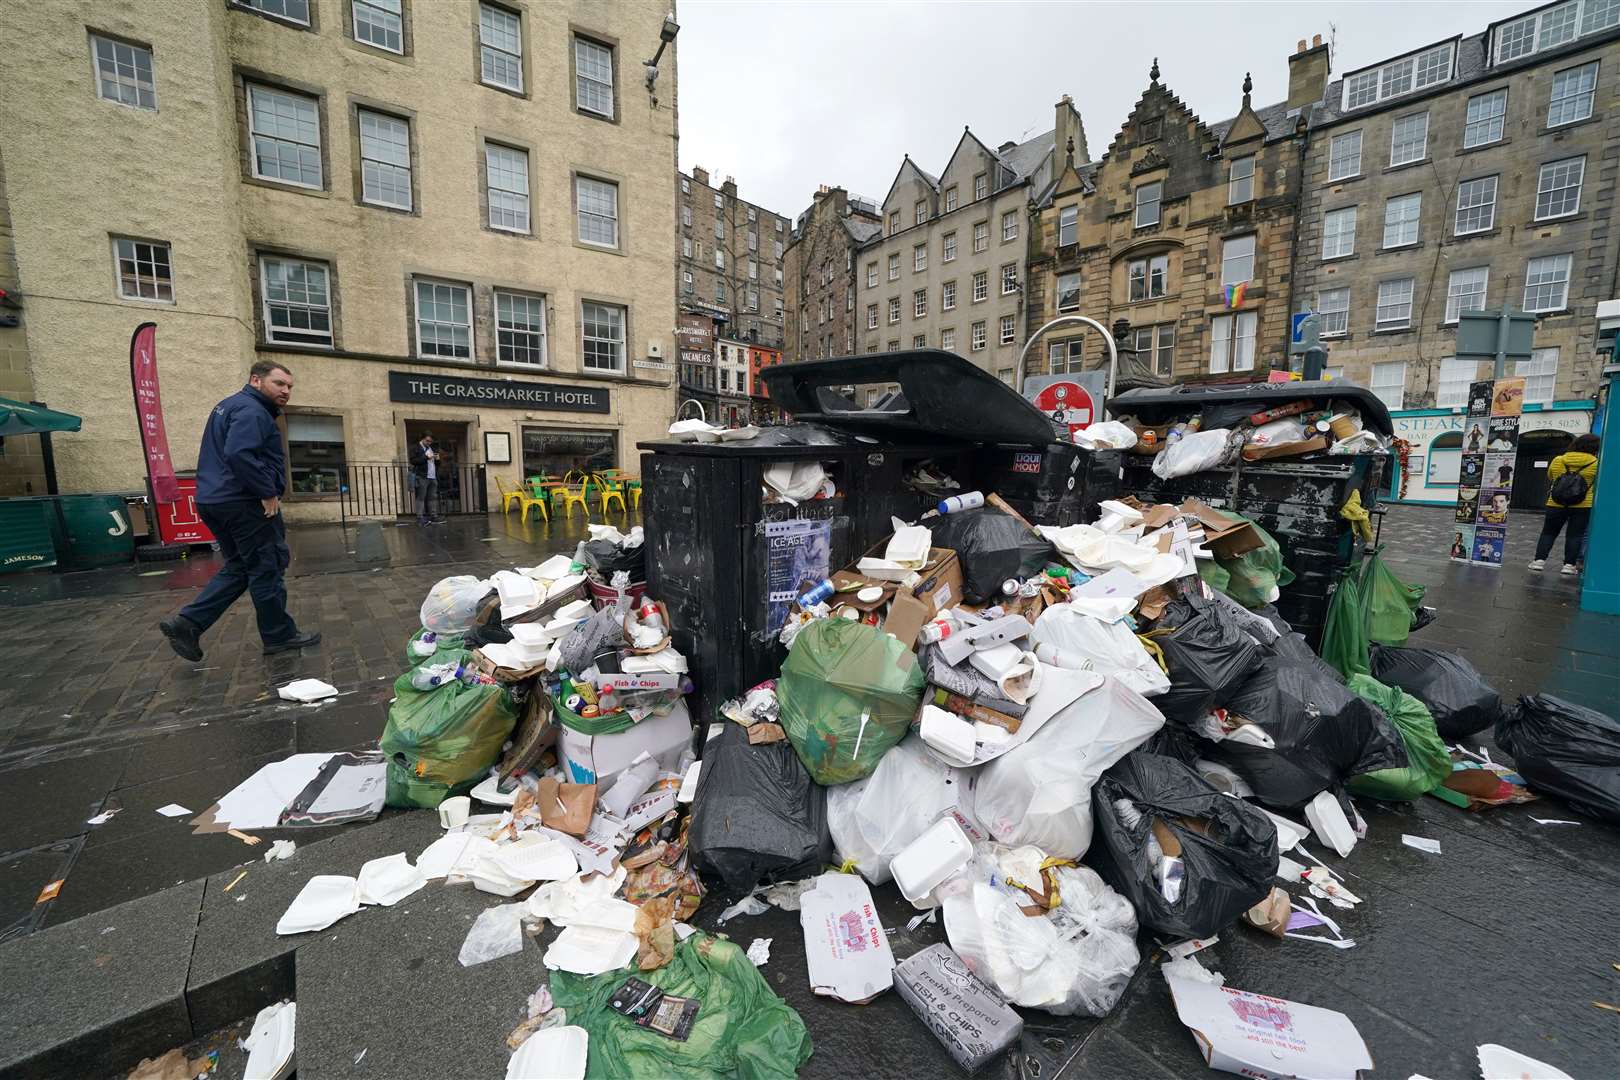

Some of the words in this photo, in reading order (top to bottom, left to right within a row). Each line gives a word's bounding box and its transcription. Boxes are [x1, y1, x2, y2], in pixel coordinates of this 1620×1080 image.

[681, 351, 712, 363] VACANCIES
[408, 380, 441, 396] THE
[444, 383, 551, 403] GRASSMARKET
[554, 391, 597, 406] HOTEL
[1399, 416, 1464, 432] STEAK
[1016, 454, 1040, 463] LIQUI
[1014, 463, 1039, 472] MOLY
[770, 537, 786, 548] ICE
[788, 535, 806, 546] AGE
[3, 554, 45, 565] JAMESON
[614, 679, 629, 687] Fish
[630, 679, 638, 687] &
[639, 680, 660, 688] Chips
[863, 904, 873, 918] Fish
[870, 927, 880, 949] Chips
[919, 970, 952, 997] Freshly
[952, 994, 1000, 1026] Prepared
[912, 982, 937, 1003] FISH
[937, 1003, 946, 1012] &
[948, 1011, 982, 1039] CHIPS
